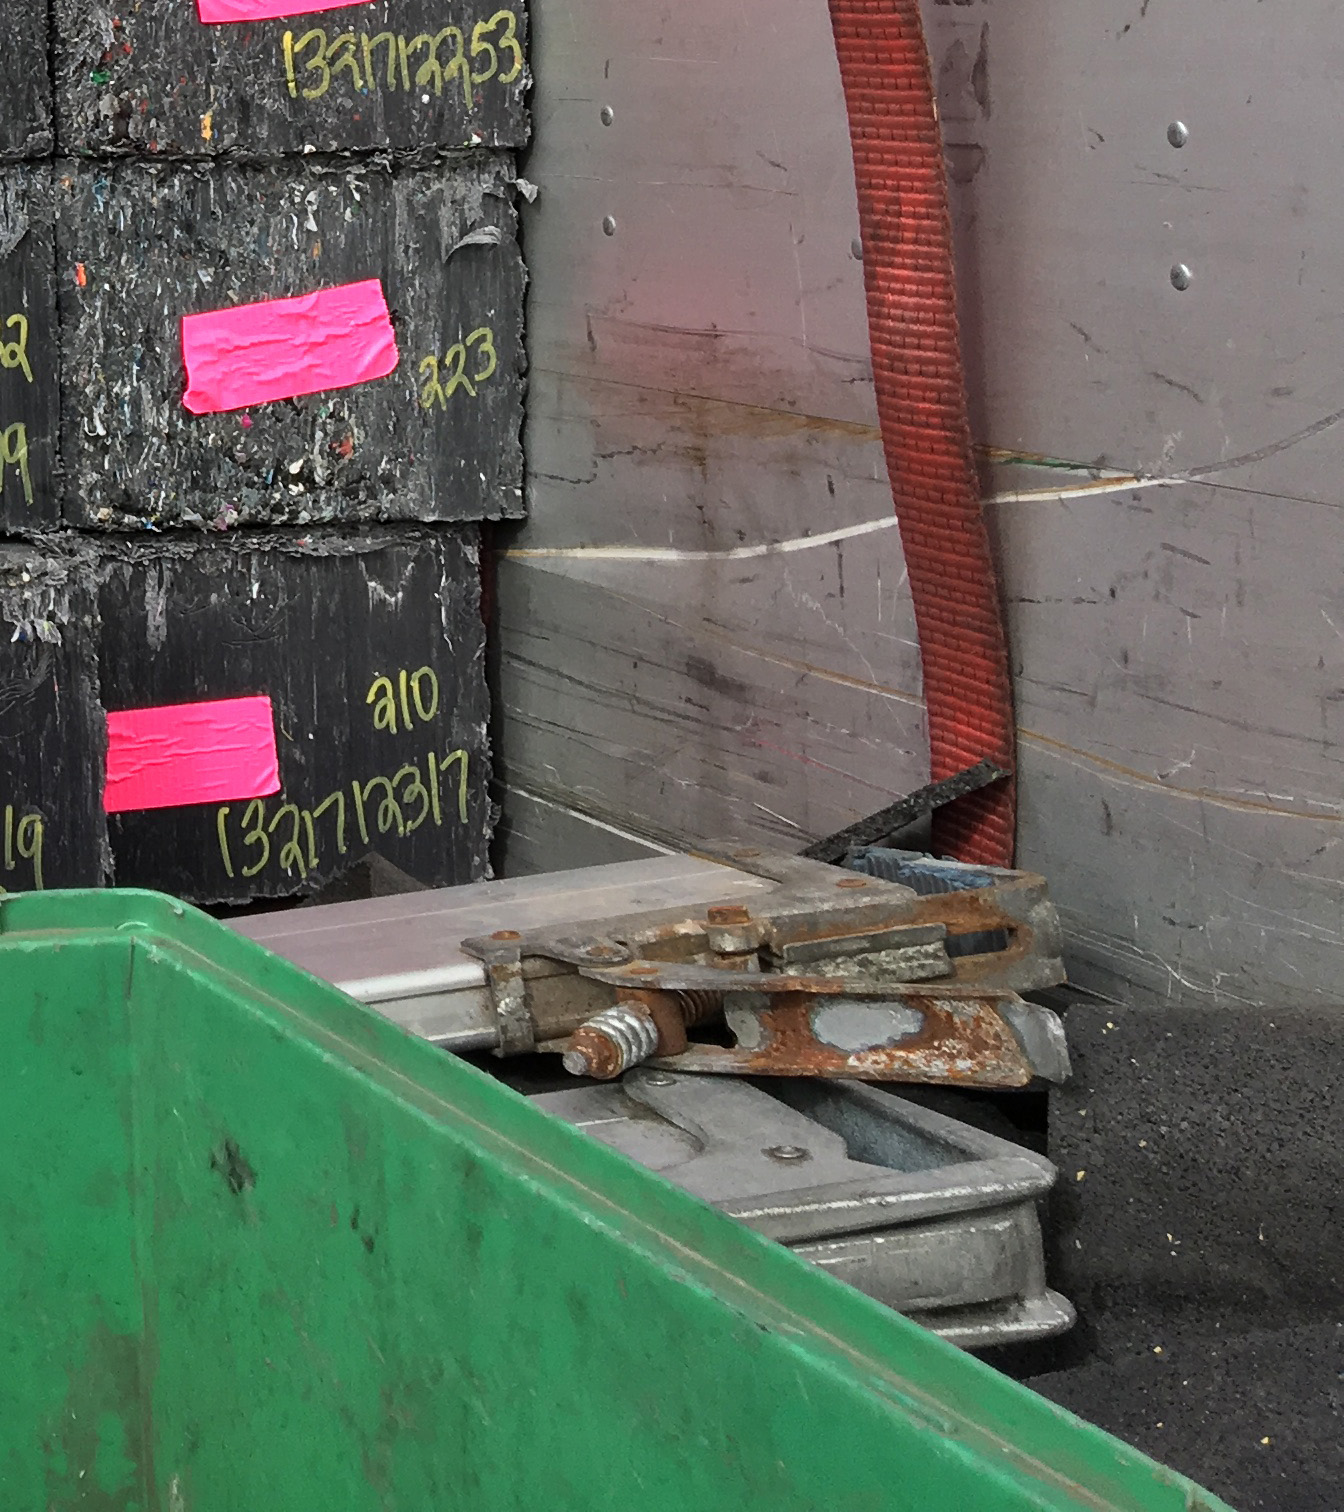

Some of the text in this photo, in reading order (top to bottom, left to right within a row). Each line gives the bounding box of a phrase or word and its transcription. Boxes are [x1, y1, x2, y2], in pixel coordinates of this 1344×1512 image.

[282, 10, 523, 110] 1321712253
[419, 327, 497, 412] 223
[365, 666, 439, 734] 210
[217, 749, 469, 878] 1321712317
